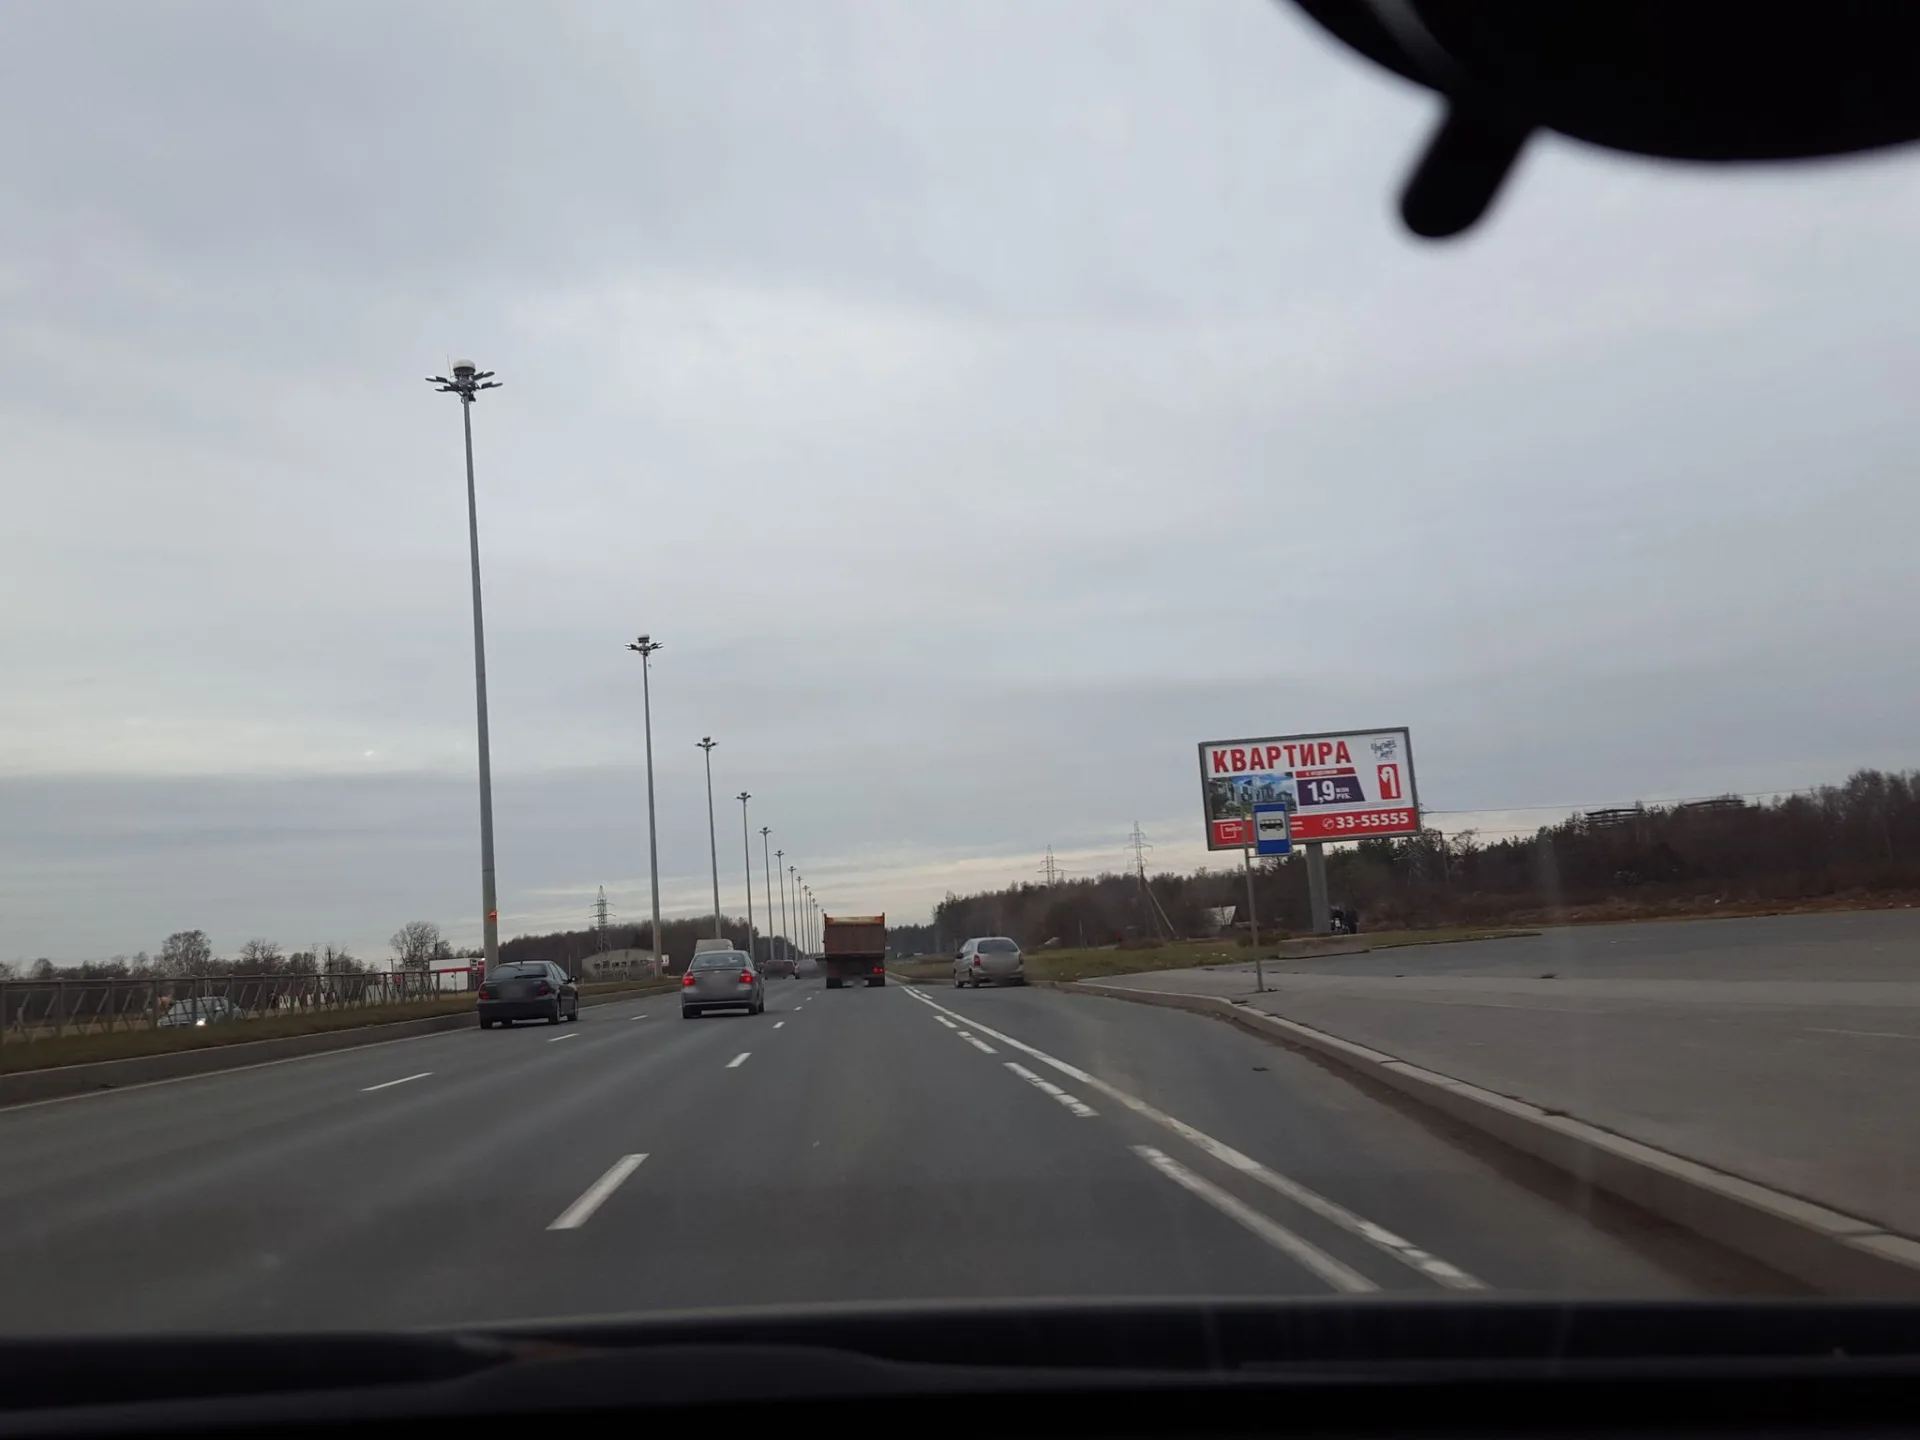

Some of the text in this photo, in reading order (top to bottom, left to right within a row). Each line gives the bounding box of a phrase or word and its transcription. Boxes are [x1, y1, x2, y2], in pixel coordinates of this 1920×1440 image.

[1212, 740, 1352, 773] КВАРТИРА
[1307, 780, 1336, 804] 1,9
[1335, 811, 1409, 829] 33-55555
